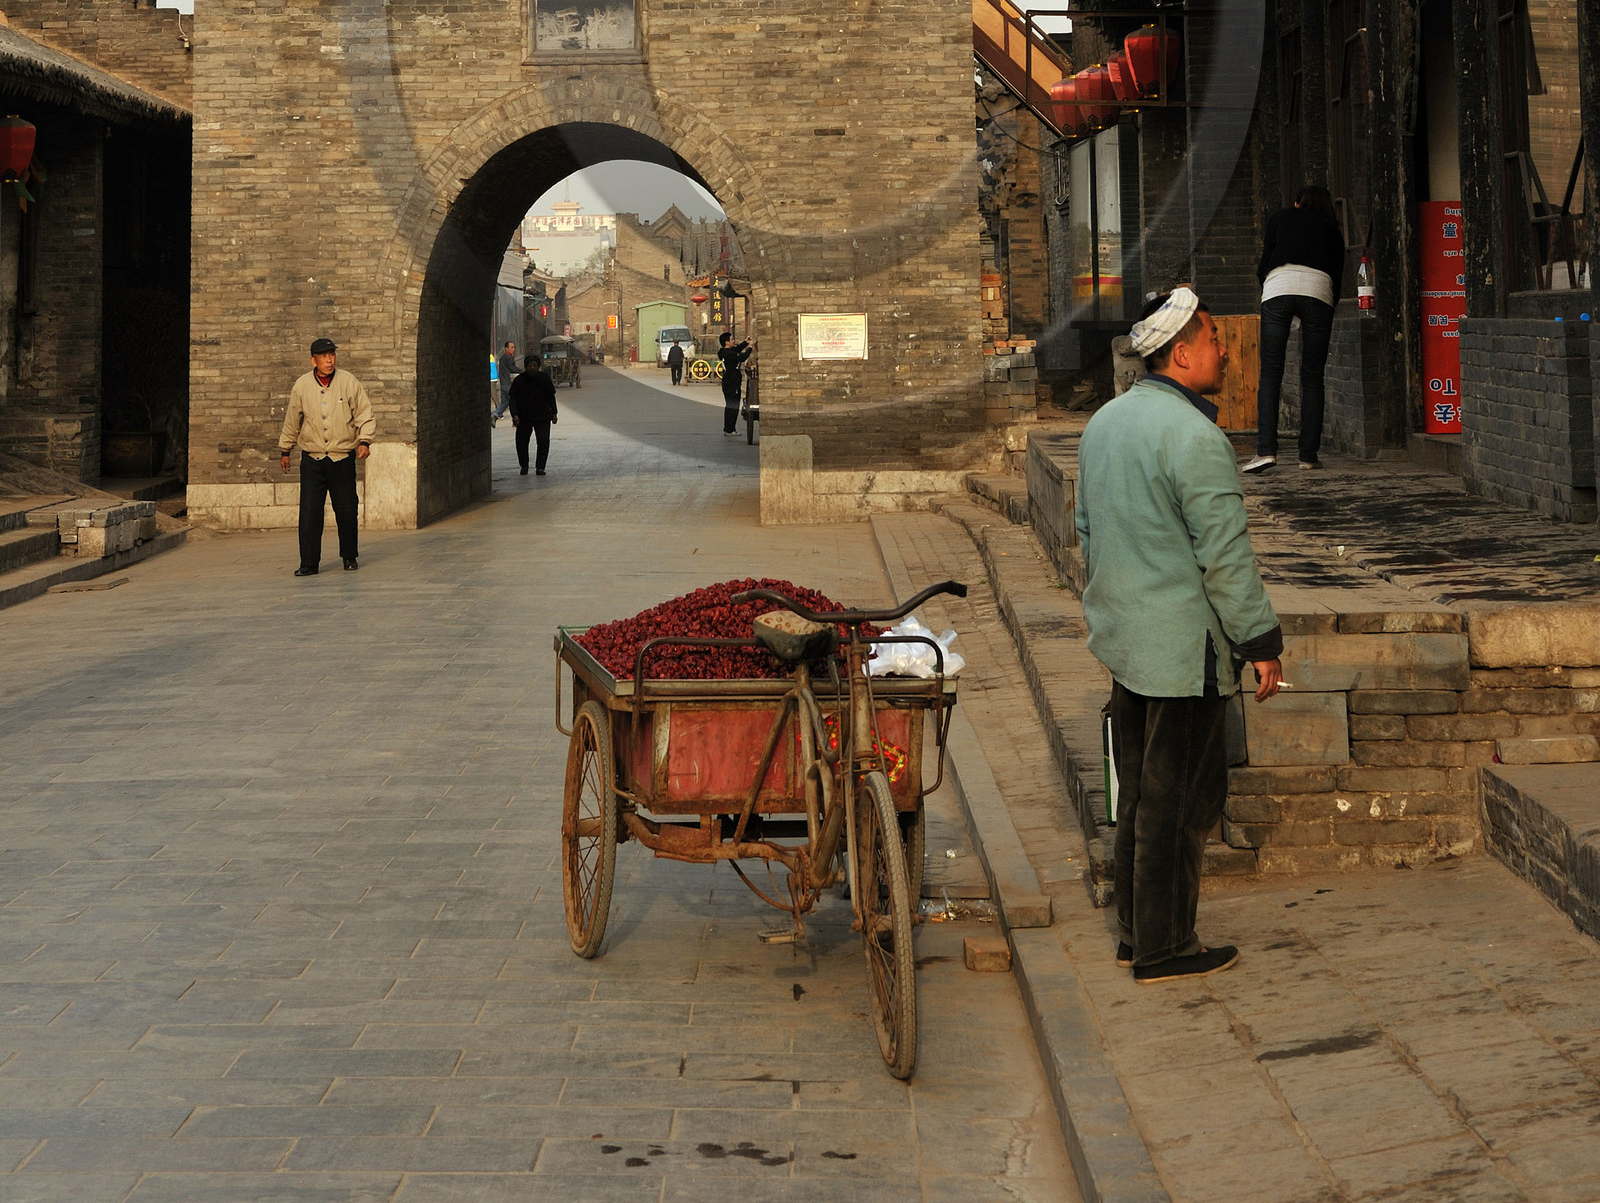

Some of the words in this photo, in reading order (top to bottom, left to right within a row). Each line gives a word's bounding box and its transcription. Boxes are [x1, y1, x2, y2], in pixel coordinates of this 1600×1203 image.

[1442, 250, 1458, 258] arts
[1428, 315, 1467, 327] 一民居
[1429, 378, 1457, 395] To
[1433, 402, 1462, 424] 去
